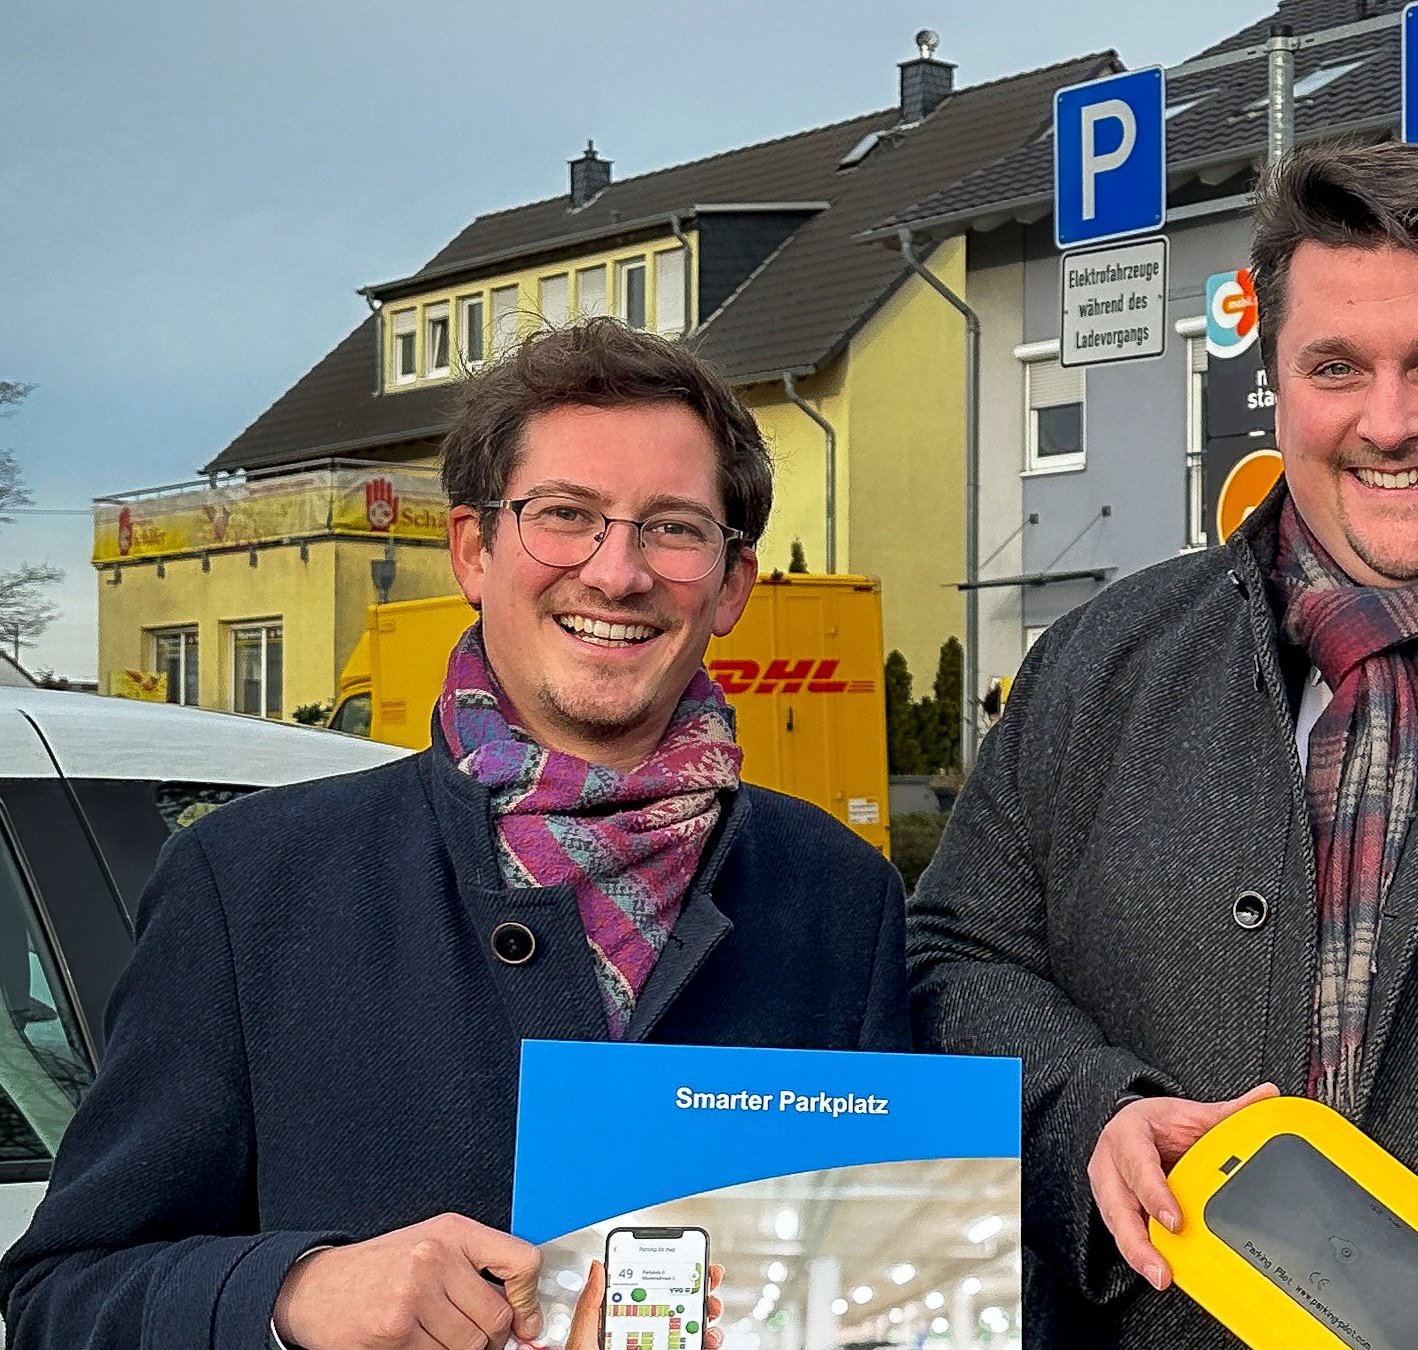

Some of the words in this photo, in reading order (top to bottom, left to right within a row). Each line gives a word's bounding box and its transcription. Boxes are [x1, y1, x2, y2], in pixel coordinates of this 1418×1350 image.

[1081, 99, 1136, 221] P
[1069, 261, 1159, 289] Elektrofahrzeuge
[1079, 293, 1124, 317] während
[1129, 292, 1148, 310] des
[1076, 326, 1149, 349] Ladevorgangs
[709, 660, 848, 694] DHL
[675, 1086, 773, 1111] Smarter
[779, 1090, 889, 1118] Parkplatz
[1244, 1240, 1272, 1269] Parking
[618, 1268, 634, 1279] 49
